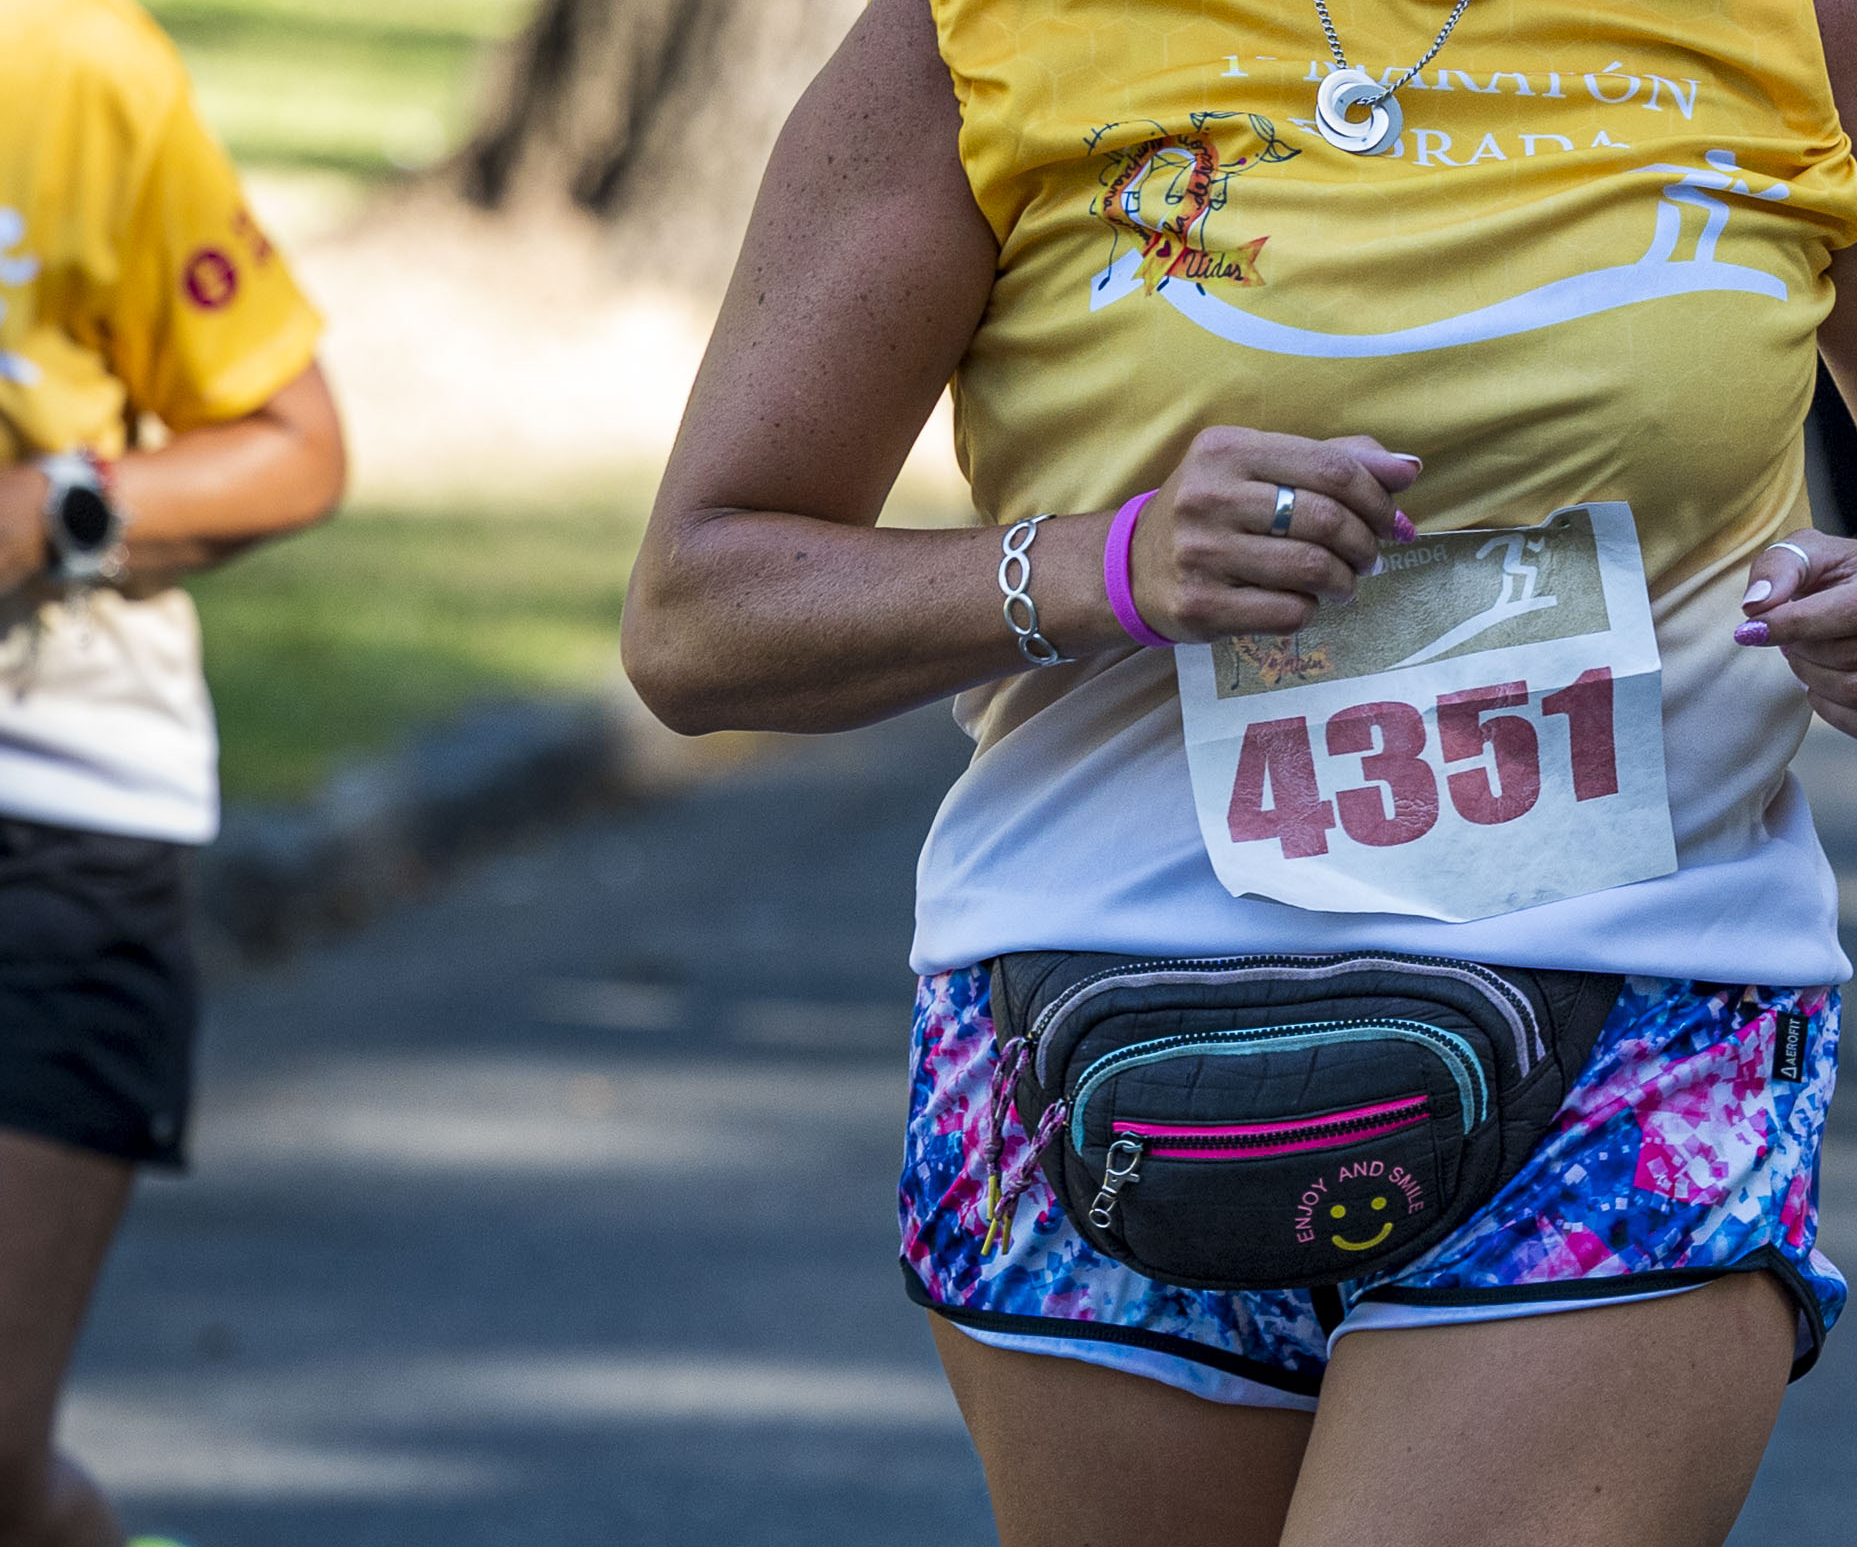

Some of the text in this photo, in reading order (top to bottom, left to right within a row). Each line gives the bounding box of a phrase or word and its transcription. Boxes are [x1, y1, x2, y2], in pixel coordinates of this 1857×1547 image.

[1227, 666, 1619, 860] 4351
[1784, 1018, 1801, 1066] AEROFIT
[1294, 1160, 1425, 1244] ENJOY AND SMILE
